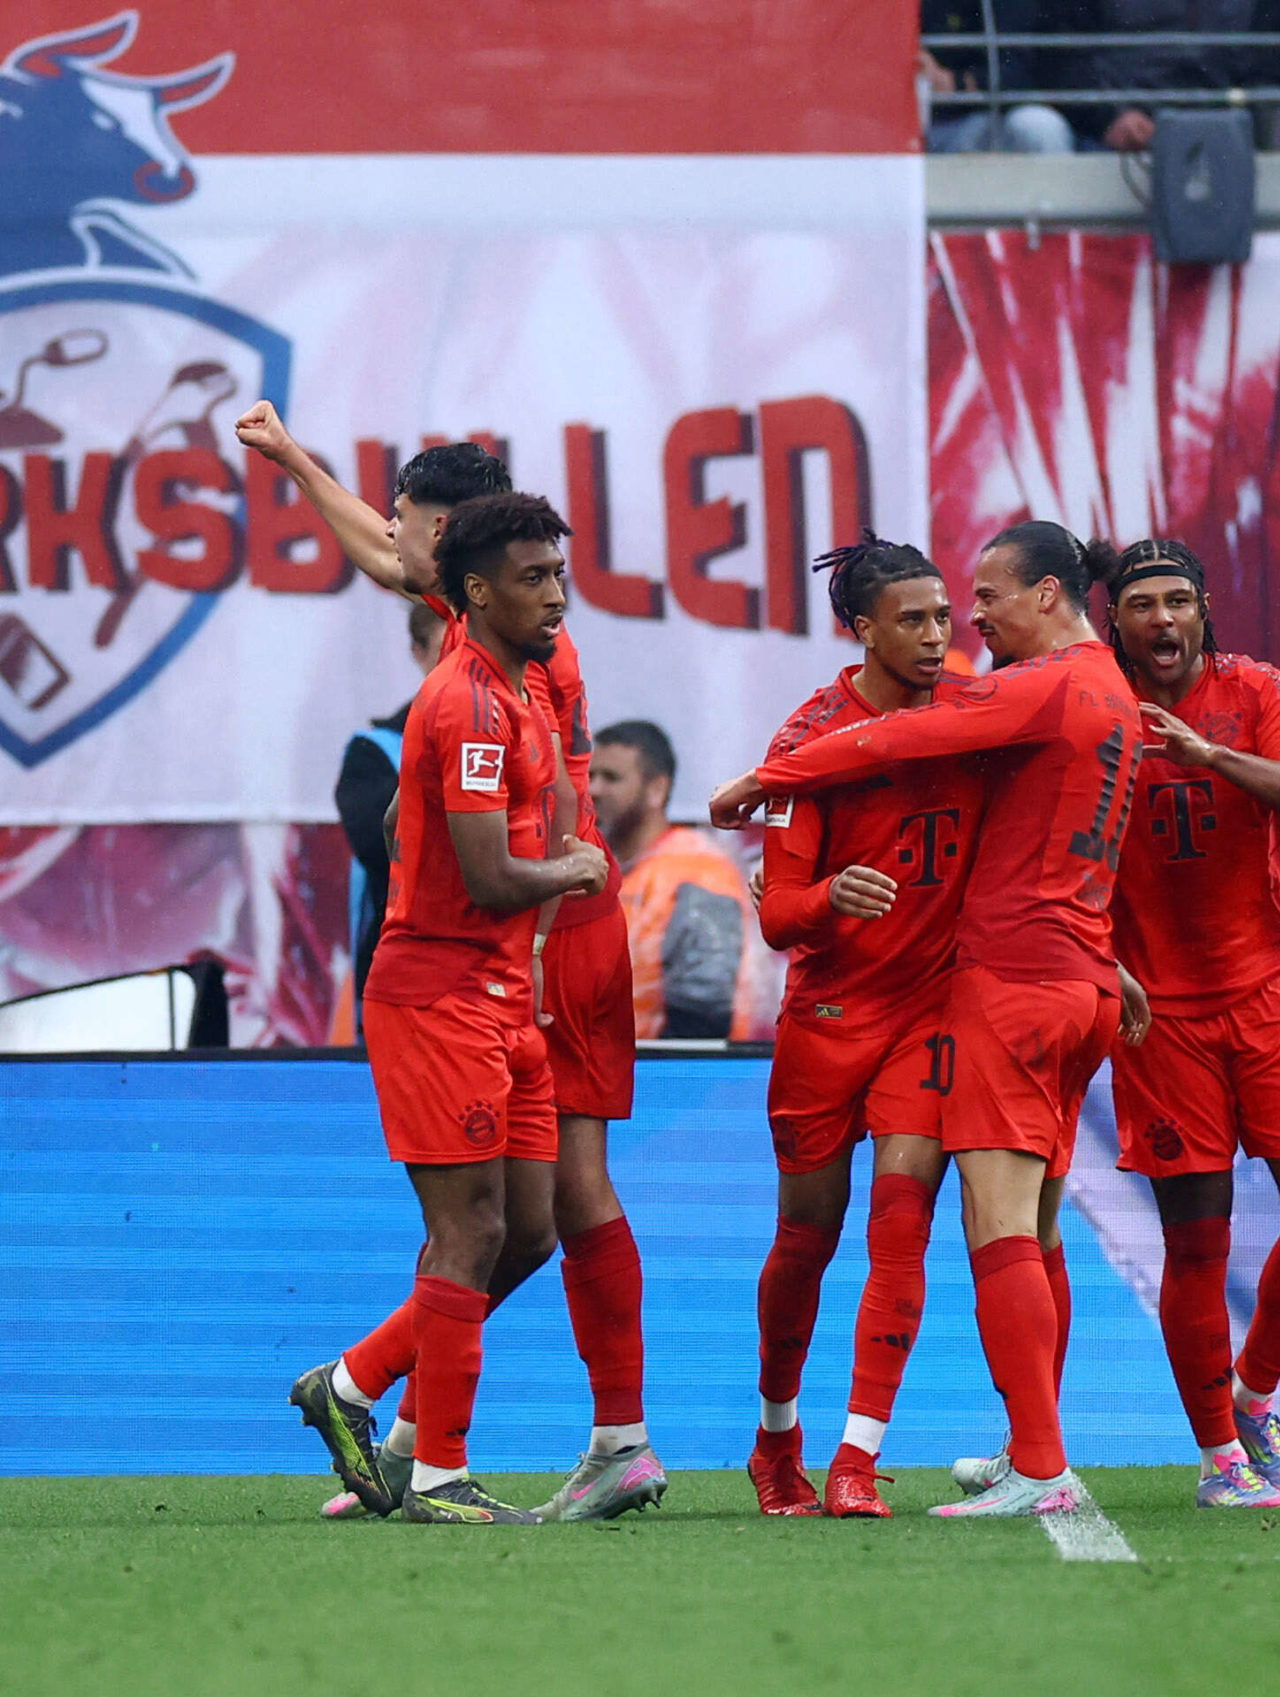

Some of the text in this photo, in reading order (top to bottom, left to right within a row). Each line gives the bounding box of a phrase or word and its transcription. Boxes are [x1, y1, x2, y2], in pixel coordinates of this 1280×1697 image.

[898, 807, 960, 887] T
[1147, 779, 1215, 860] T
[919, 1031, 956, 1097] 10
